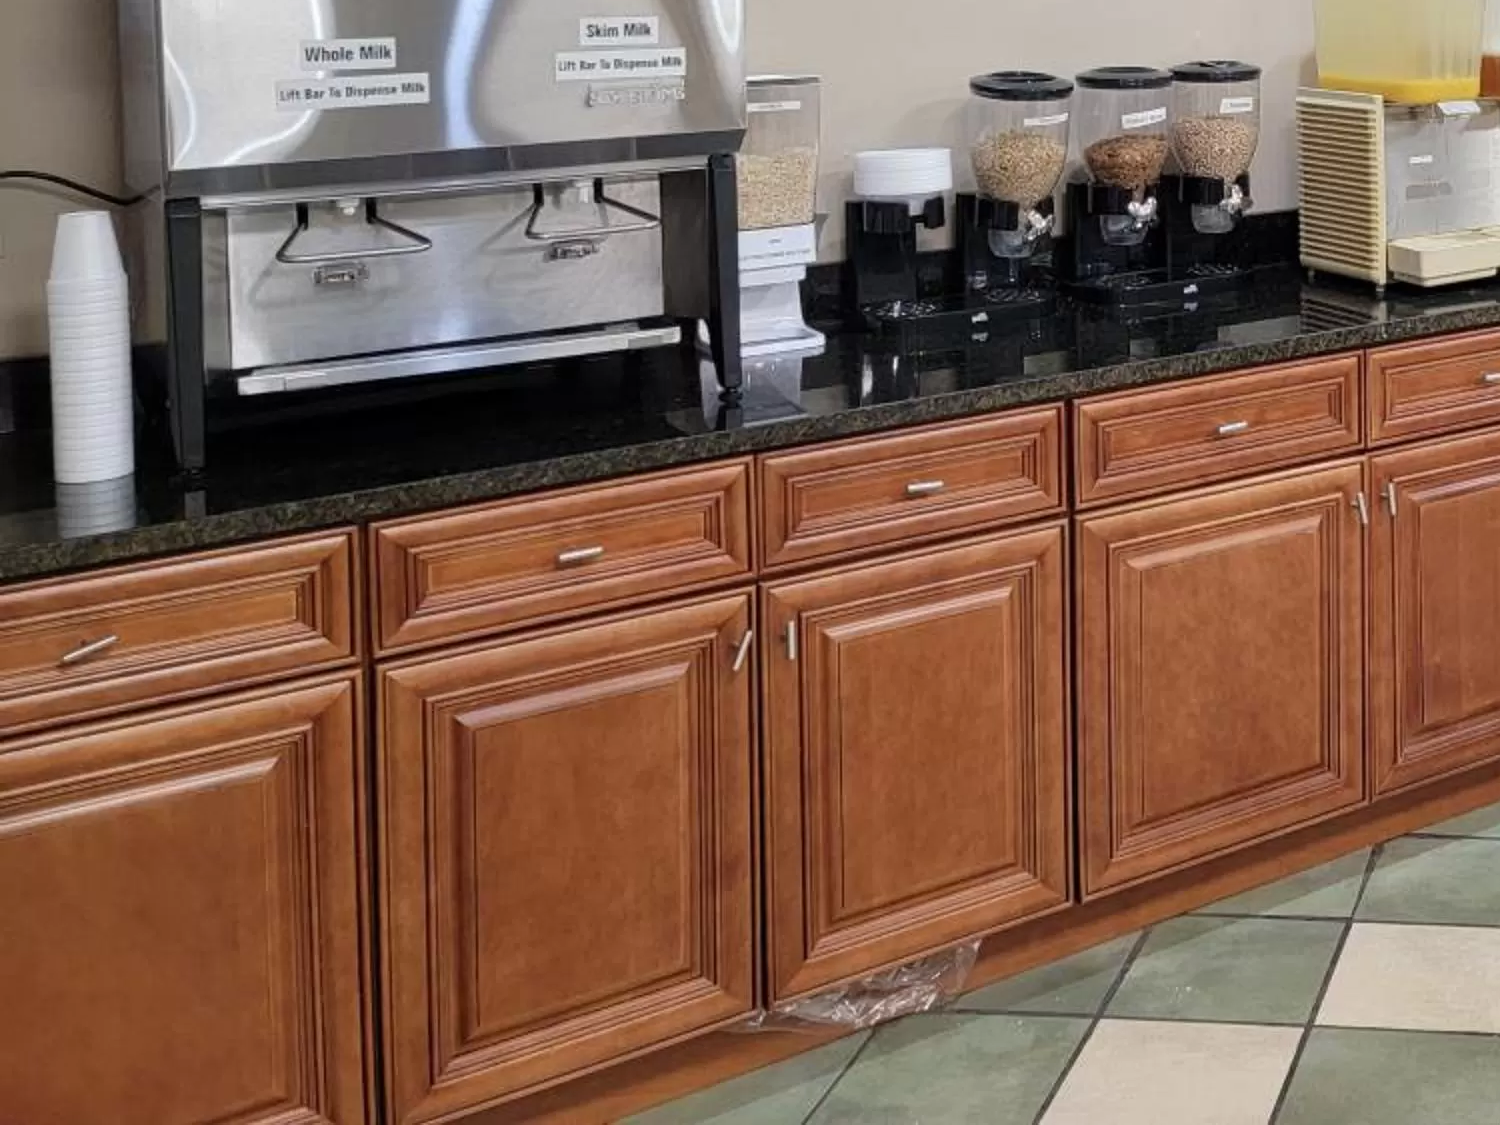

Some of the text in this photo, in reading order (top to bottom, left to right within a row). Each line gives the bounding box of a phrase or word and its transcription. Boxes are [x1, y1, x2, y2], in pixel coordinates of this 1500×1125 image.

[586, 22, 651, 38] Skim Milk
[304, 44, 392, 62] Whole Milk
[279, 81, 426, 103] Lift Bar To Dispense Milk
